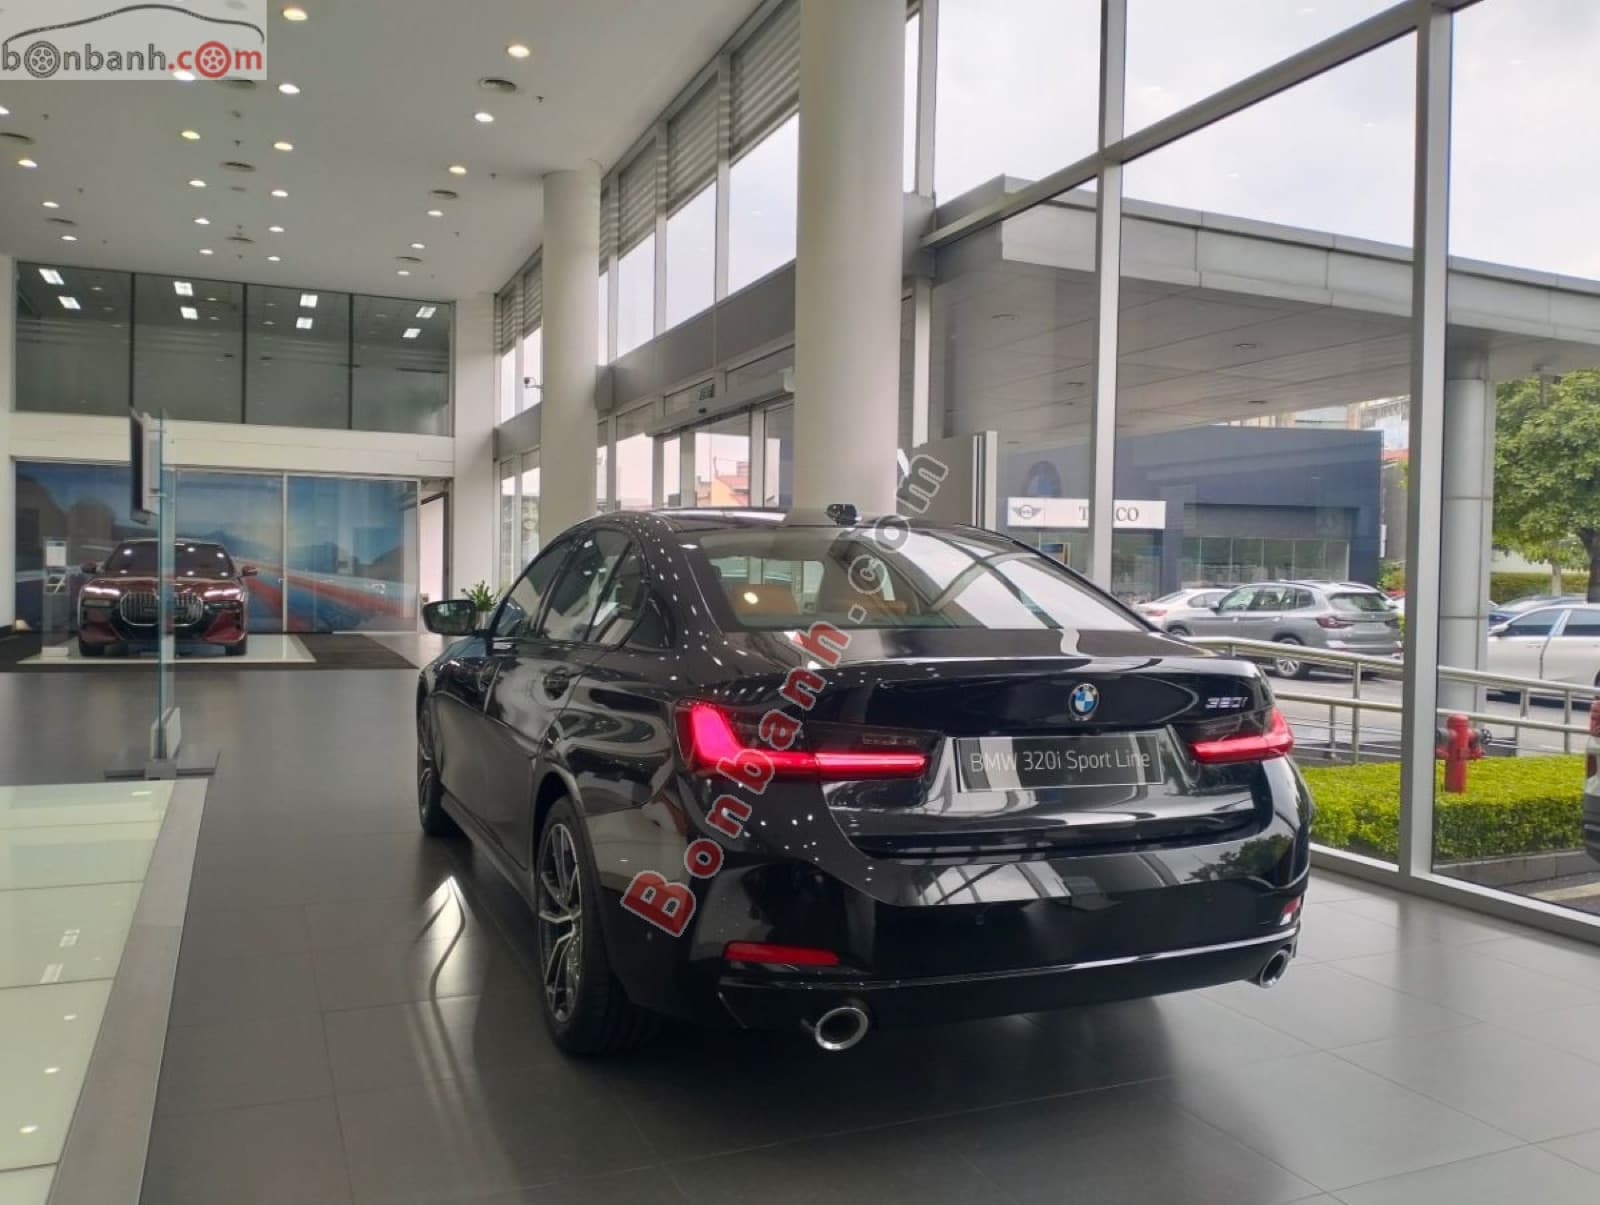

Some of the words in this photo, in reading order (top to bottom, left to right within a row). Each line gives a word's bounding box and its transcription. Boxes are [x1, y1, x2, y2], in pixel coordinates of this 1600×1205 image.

[1078, 506, 1139, 521] TCO
[969, 752, 1017, 772] BMW
[1023, 751, 1061, 771] 320i
[1066, 750, 1112, 772] Sport
[1116, 749, 1151, 768] Line
